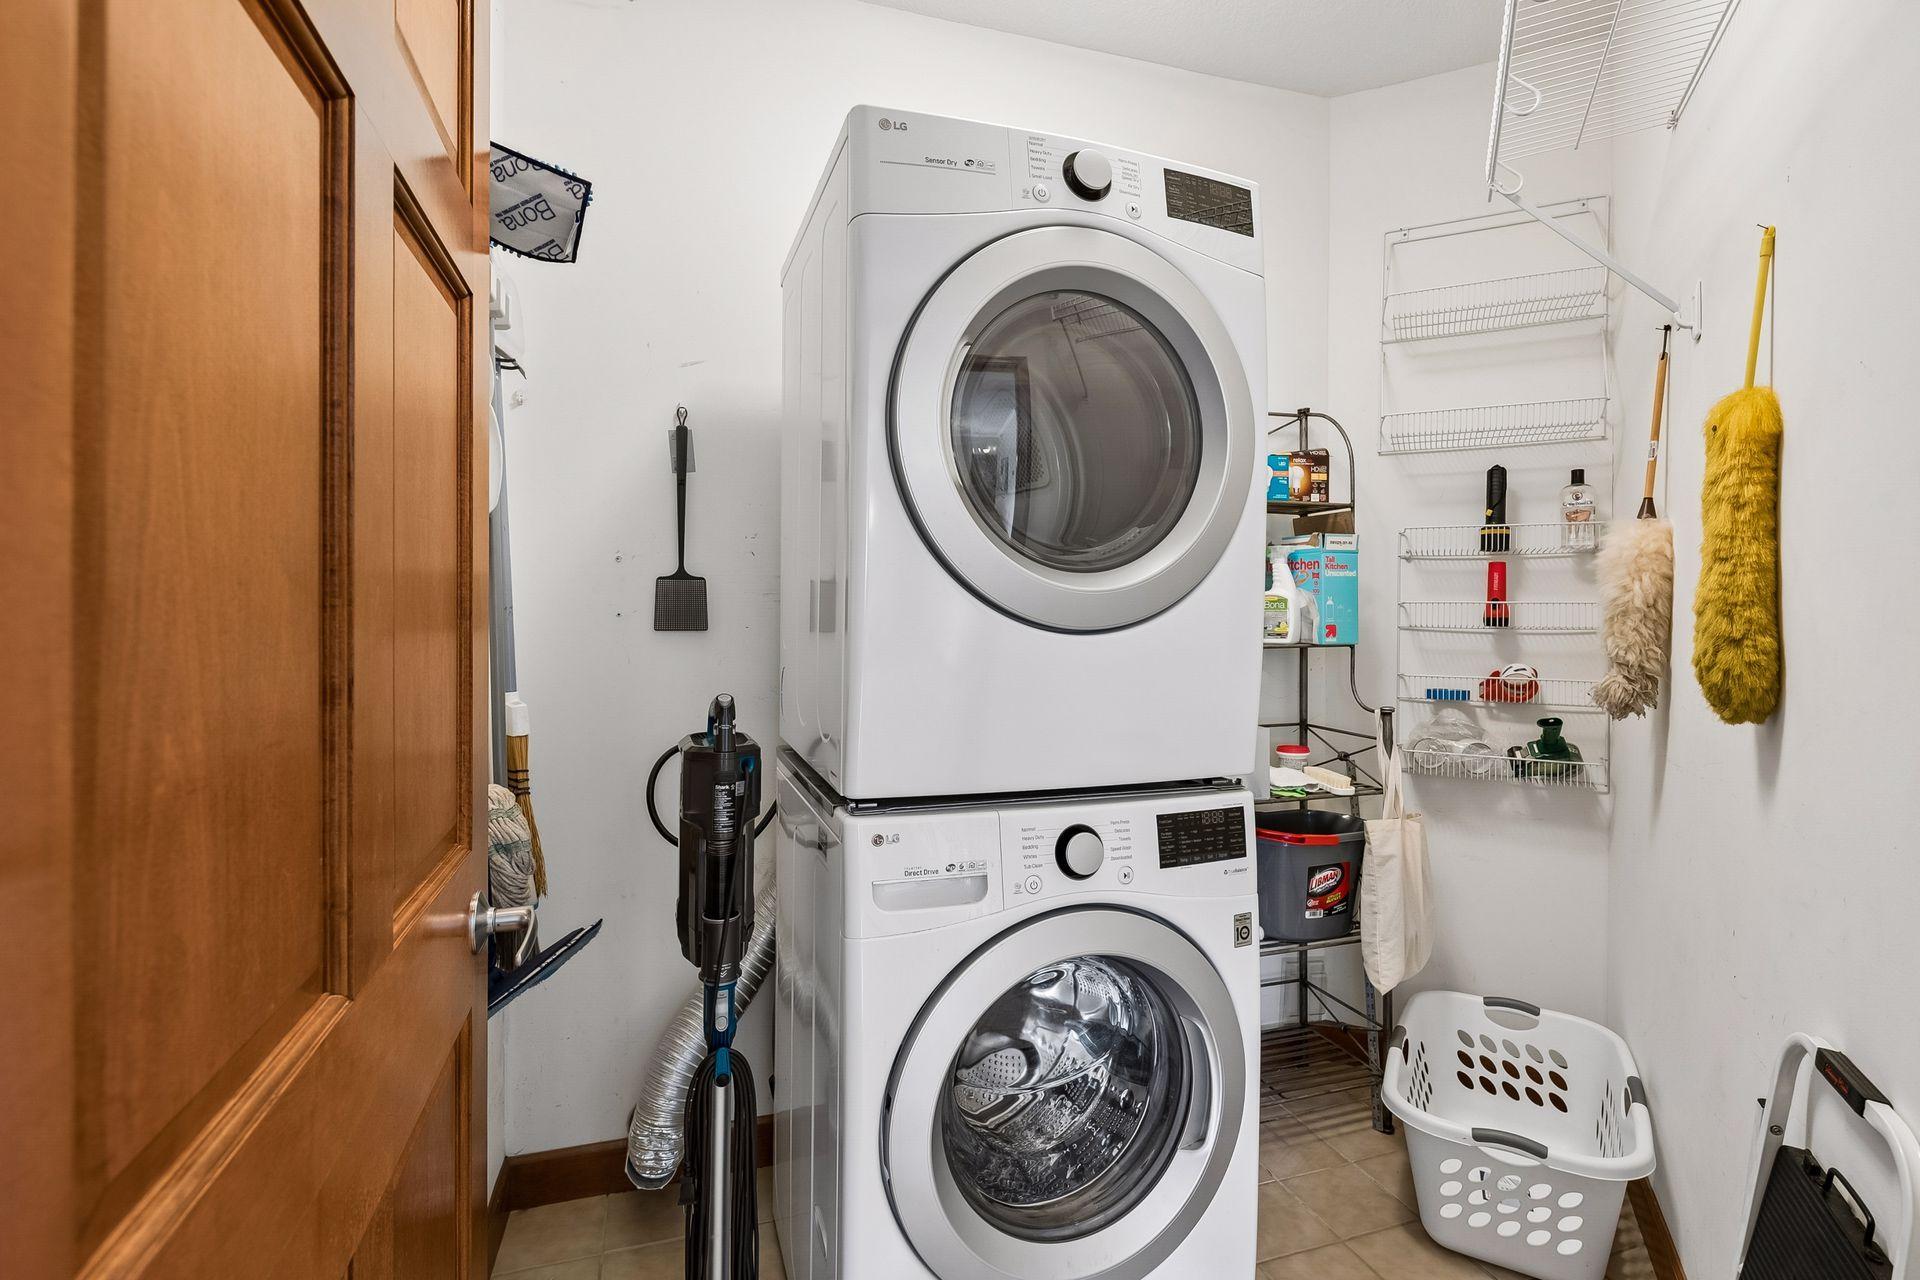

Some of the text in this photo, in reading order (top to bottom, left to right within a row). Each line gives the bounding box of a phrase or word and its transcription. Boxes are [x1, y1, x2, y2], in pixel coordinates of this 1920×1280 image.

[490, 157, 543, 182] ona
[924, 156, 958, 167] Sensor Dry
[499, 199, 556, 230] Bona
[904, 869, 922, 877] Direct
[923, 868, 939, 876] Drive
